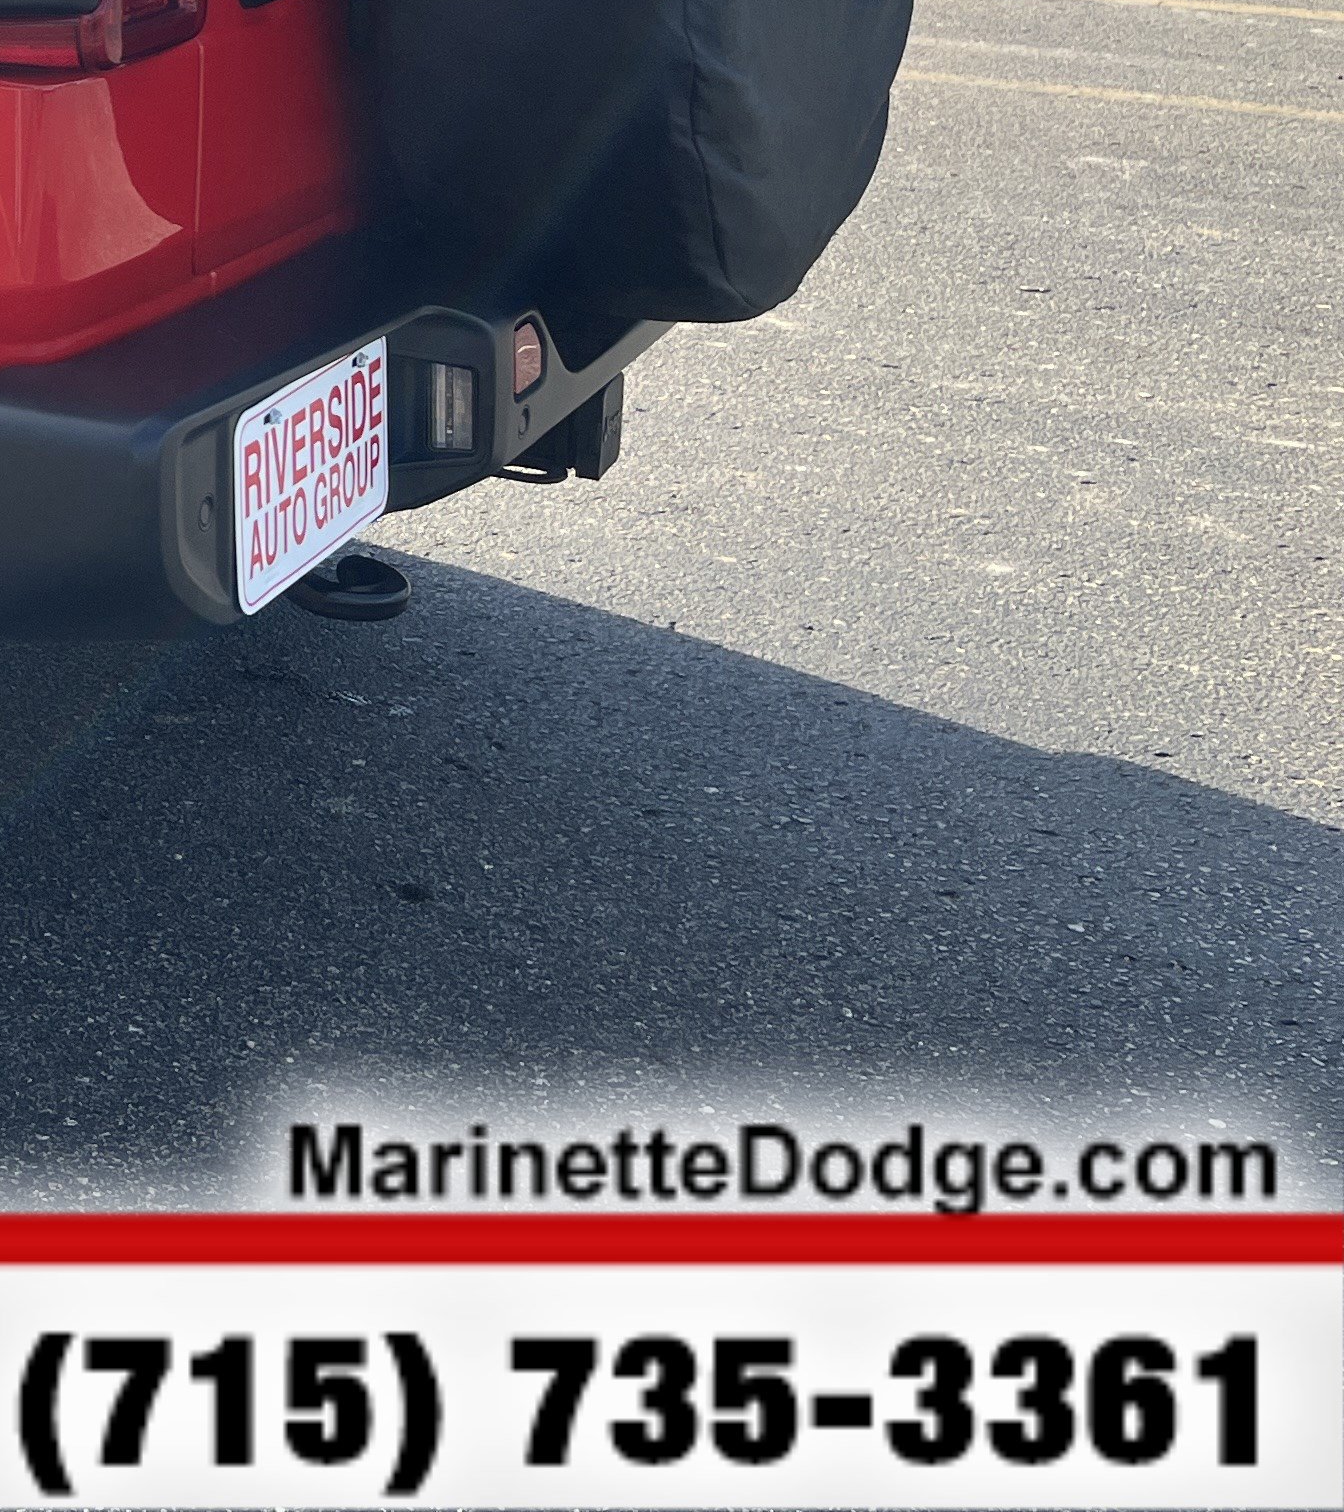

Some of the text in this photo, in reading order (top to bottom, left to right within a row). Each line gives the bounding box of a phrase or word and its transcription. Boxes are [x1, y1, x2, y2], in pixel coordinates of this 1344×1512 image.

[244, 356, 382, 519] RIVERSIDE
[248, 433, 380, 580] AUTO GROUP
